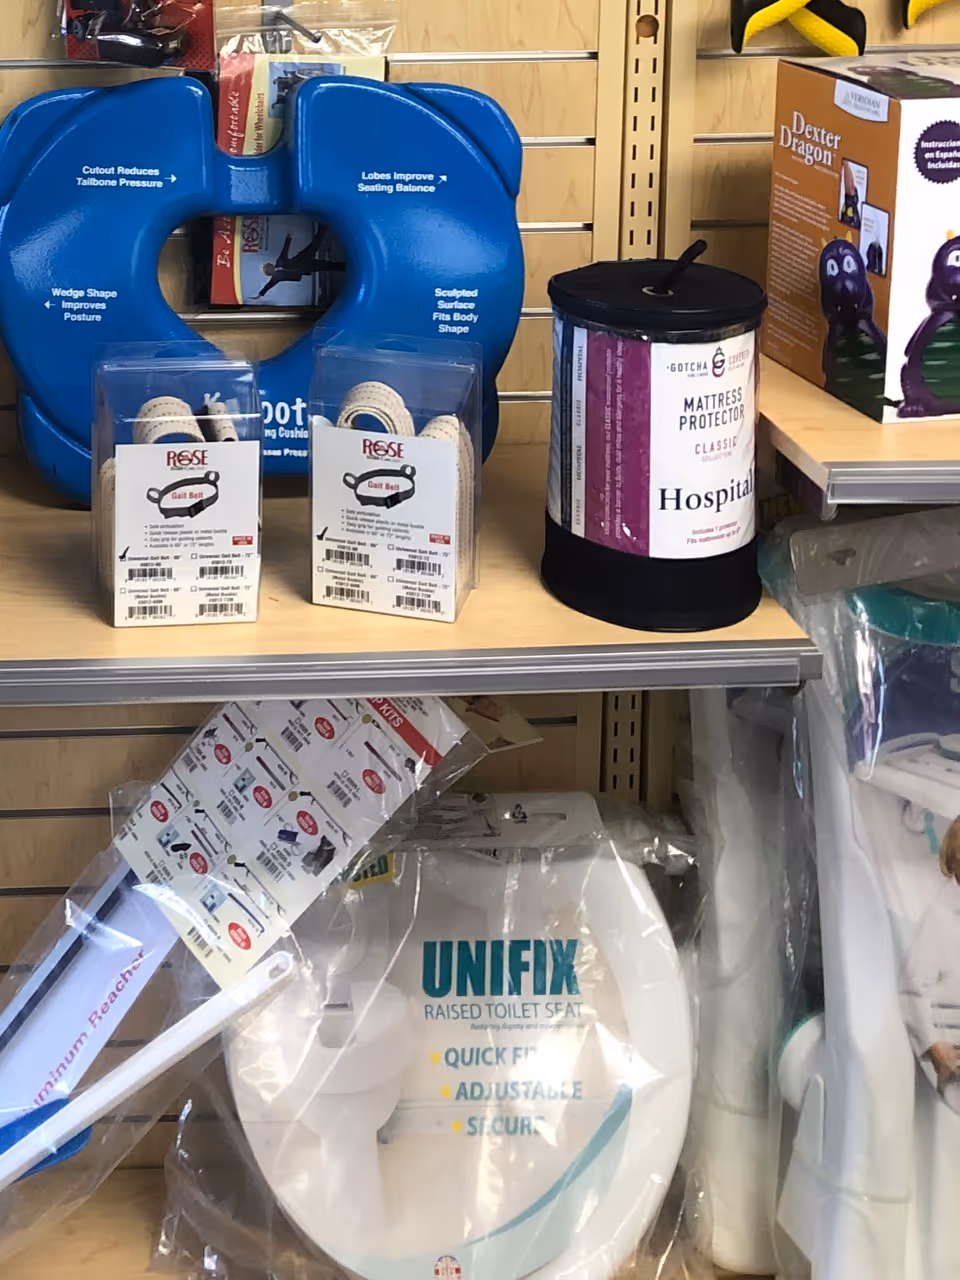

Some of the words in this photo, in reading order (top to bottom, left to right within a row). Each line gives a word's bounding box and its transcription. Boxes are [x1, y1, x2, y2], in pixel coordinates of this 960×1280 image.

[792, 111, 841, 149] Dexter
[780, 125, 833, 166] Dragon
[82, 166, 115, 176] Cutout
[118, 166, 160, 177] Reduces
[361, 171, 391, 181] Lobes
[393, 172, 434, 184] Improve
[76, 177, 116, 187] Tailbone
[119, 178, 163, 189] Pressure
[357, 183, 395, 195] Seating
[397, 183, 436, 193] Balance
[51, 288, 84, 300] Wedge
[87, 288, 117, 300] Shape
[434, 288, 478, 300] Sculpted
[61, 300, 107, 312] Improves
[437, 300, 475, 311] Surface
[64, 312, 102, 322] Posture
[432, 312, 452, 322] Fits
[454, 312, 479, 324] Body
[438, 324, 470, 336] Shape
[670, 361, 708, 372] GOTCHA
[684, 387, 742, 413] MATTRESS
[680, 403, 745, 431] PROTECTOR
[362, 438, 404, 459] ROSE
[695, 435, 737, 455] CLASSIC
[167, 450, 208, 467] ROSE
[368, 480, 384, 490] Gait
[385, 481, 400, 491] Belt
[658, 468, 753, 513] Hospital
[171, 491, 187, 500] Gait
[188, 491, 204, 500] Belt
[380, 703, 403, 728] KITS
[422, 940, 580, 998] UNIFIX
[87, 948, 146, 1029] Reacher
[424, 1003, 482, 1020] RAISED
[485, 1002, 539, 1019] TOILET
[545, 1002, 583, 1019] SEAT
[444, 1047, 506, 1068] QUICK
[456, 1080, 583, 1101] ADJUSTABLE
[467, 1116, 545, 1137] SECURE
